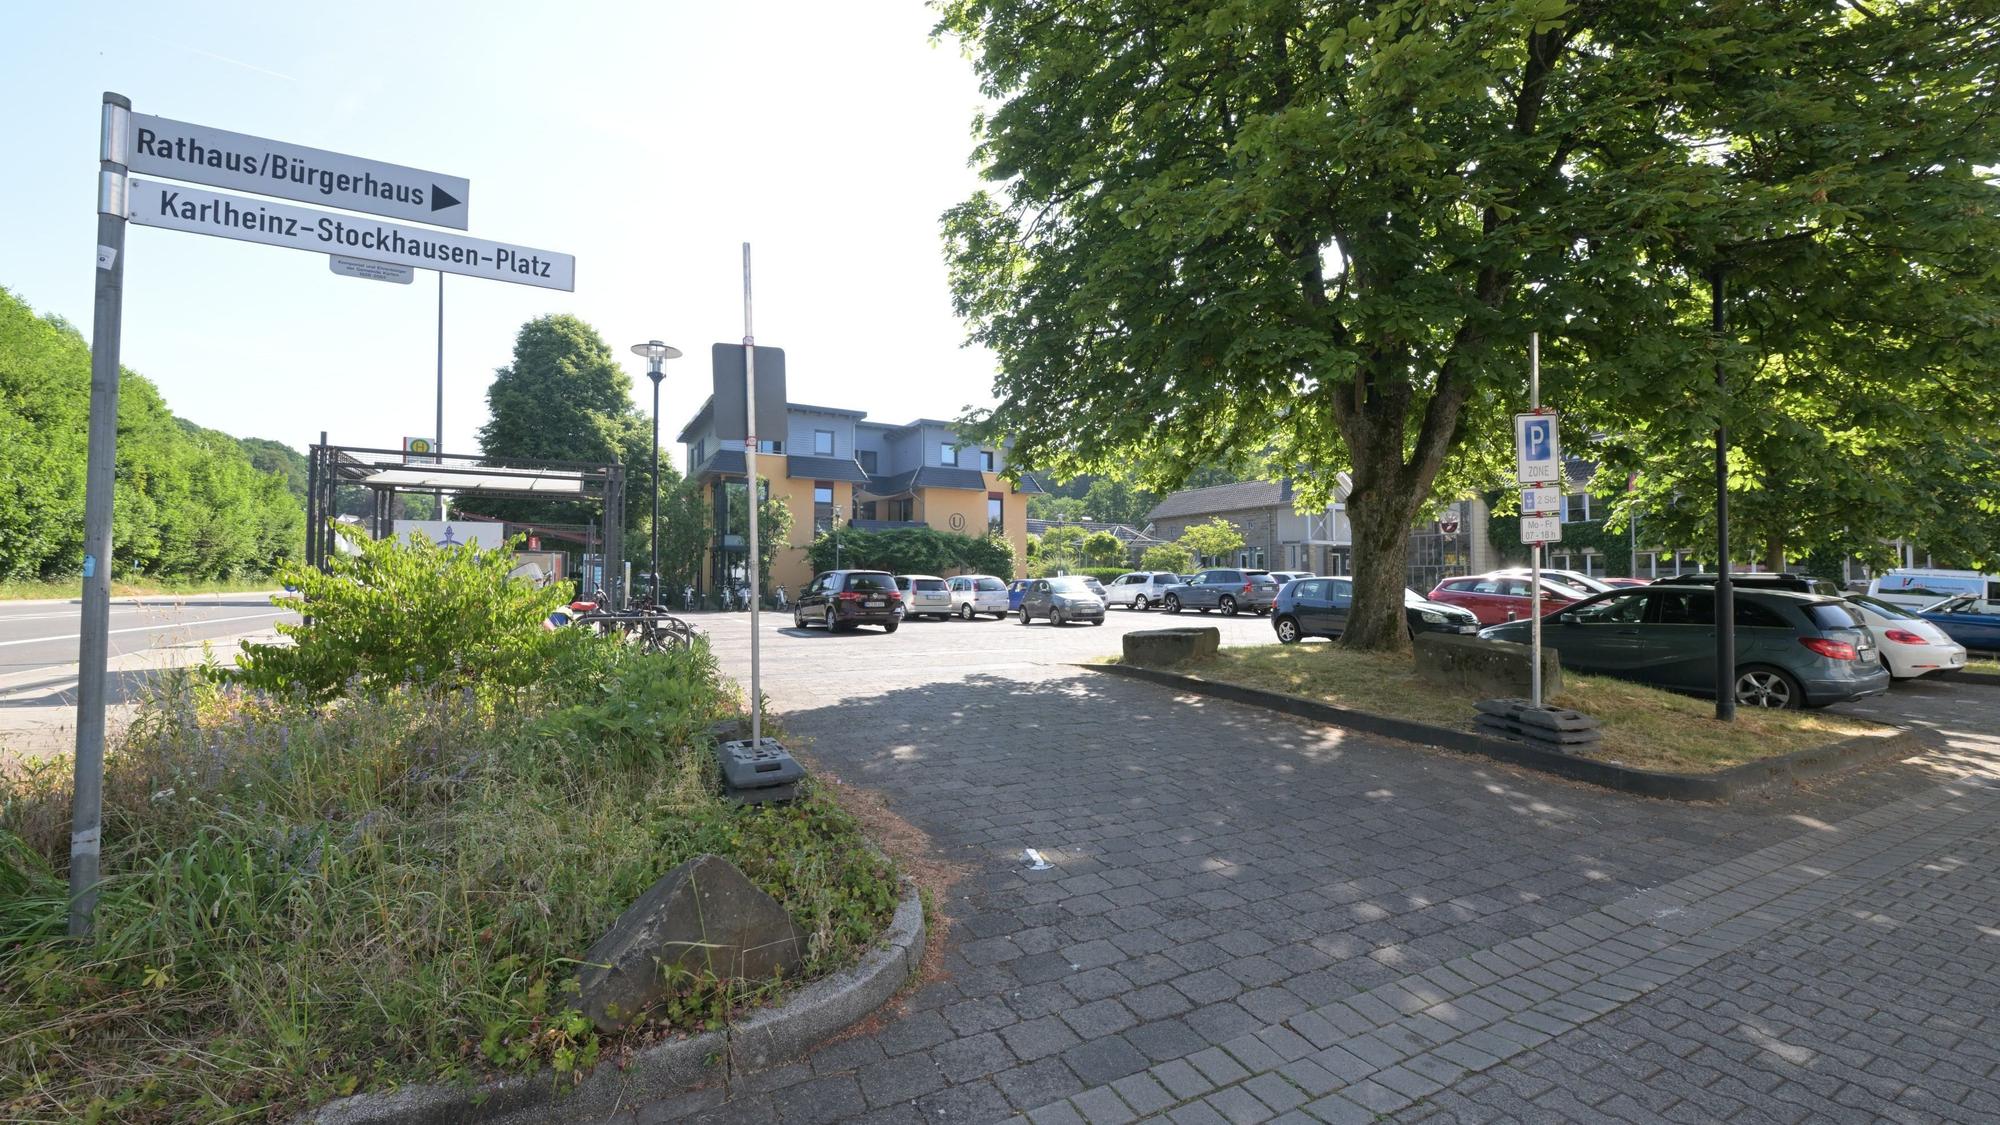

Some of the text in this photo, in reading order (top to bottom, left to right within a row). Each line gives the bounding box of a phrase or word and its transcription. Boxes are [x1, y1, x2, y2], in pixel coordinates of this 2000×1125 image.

[136, 128, 424, 206] Rathaus/Bürgerhaus
[160, 190, 552, 280] Karlheinz-Stockhausen-Platz
[1530, 425, 1544, 455] P
[1528, 465, 1550, 478] ZONE
[1528, 521, 1539, 530] Mo
[1545, 520, 1552, 528] Fr
[1525, 532, 1534, 540] 07
